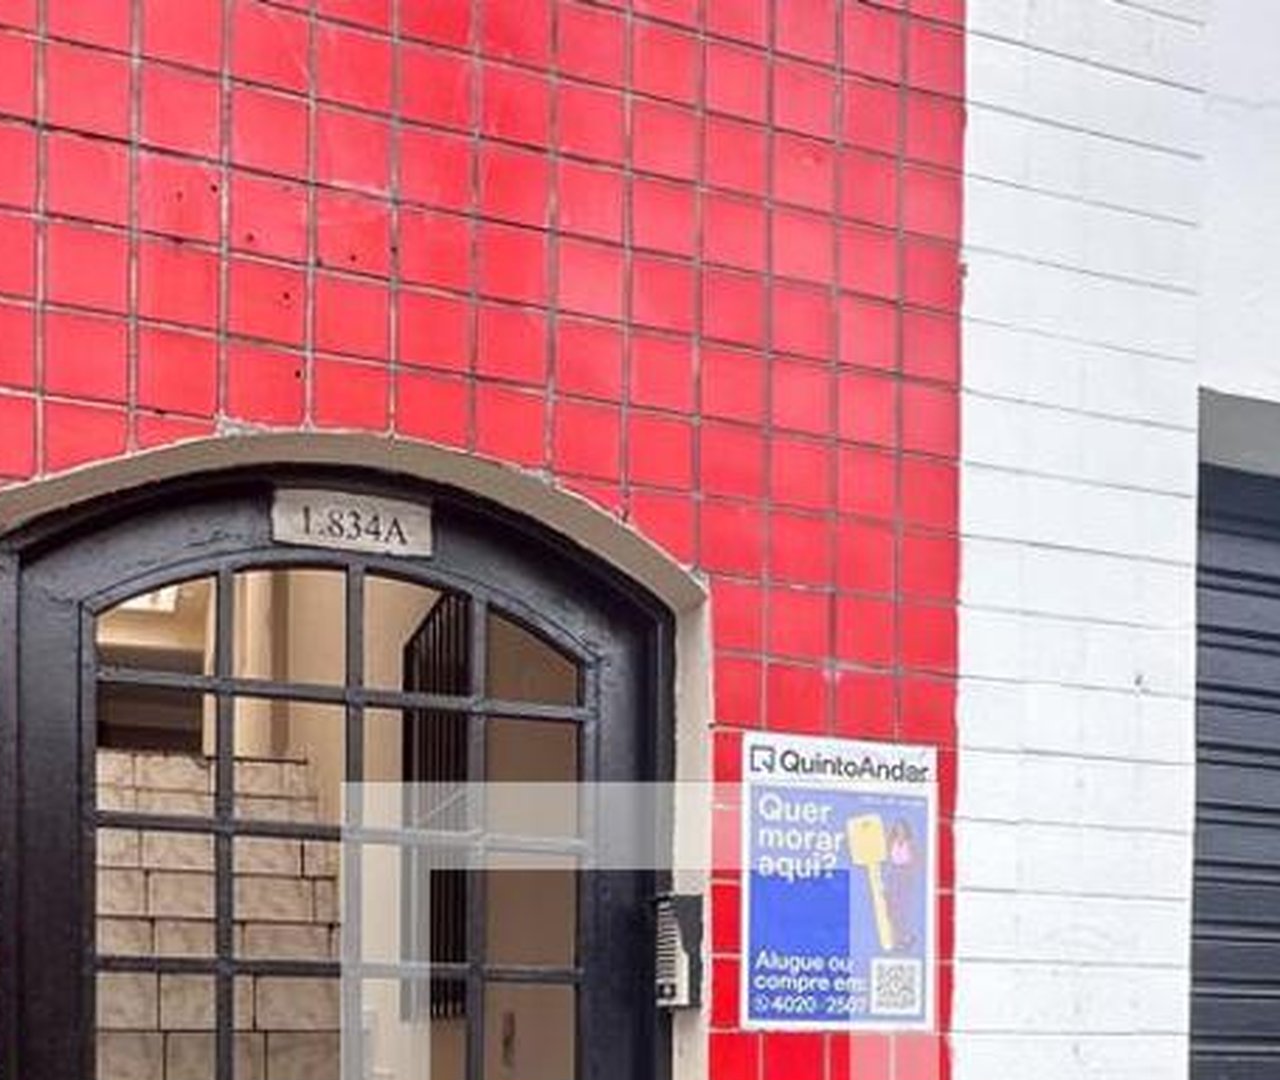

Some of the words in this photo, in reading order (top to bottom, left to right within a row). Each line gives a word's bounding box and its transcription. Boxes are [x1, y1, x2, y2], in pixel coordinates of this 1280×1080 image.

[301, 505, 408, 545] 1.834A
[780, 750, 930, 783] QuintoAndar
[758, 792, 833, 823] Quer
[758, 827, 845, 852] morar
[758, 851, 837, 884] aqui?
[754, 950, 825, 976] Alugue
[827, 956, 856, 975] ou
[753, 974, 831, 993] compre
